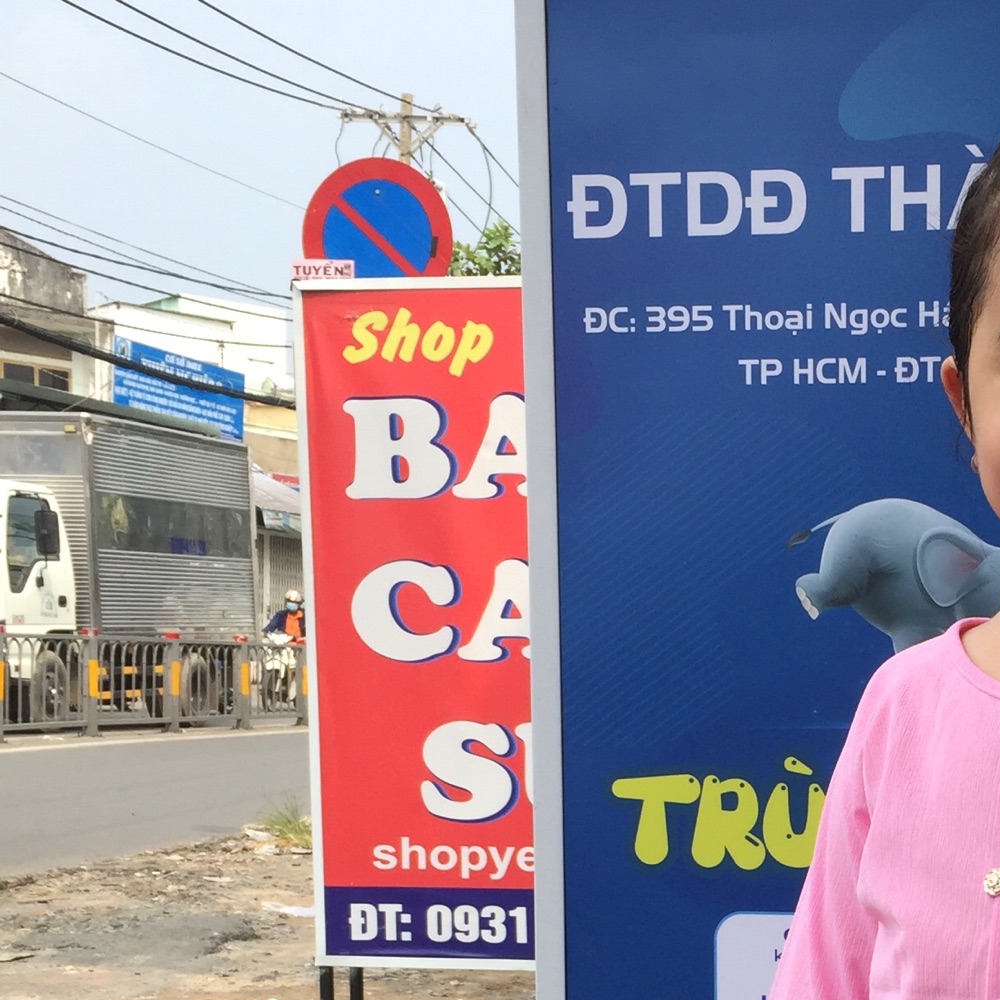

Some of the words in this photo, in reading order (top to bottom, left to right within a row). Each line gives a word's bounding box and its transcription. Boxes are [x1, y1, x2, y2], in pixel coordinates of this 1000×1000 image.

[567, 169, 807, 239] ĐTDĐ
[583, 306, 636, 333] ĐC:
[645, 305, 714, 333] 395
[722, 302, 813, 336] Thoại
[824, 302, 908, 335] Ngọc
[342, 306, 494, 377] Shop
[738, 359, 783, 385] TP
[793, 357, 867, 385] HCM
[612, 756, 827, 870] TRÙ
[372, 836, 534, 880] shopye
[349, 903, 412, 941] ĐT:
[426, 904, 528, 944] 0931
